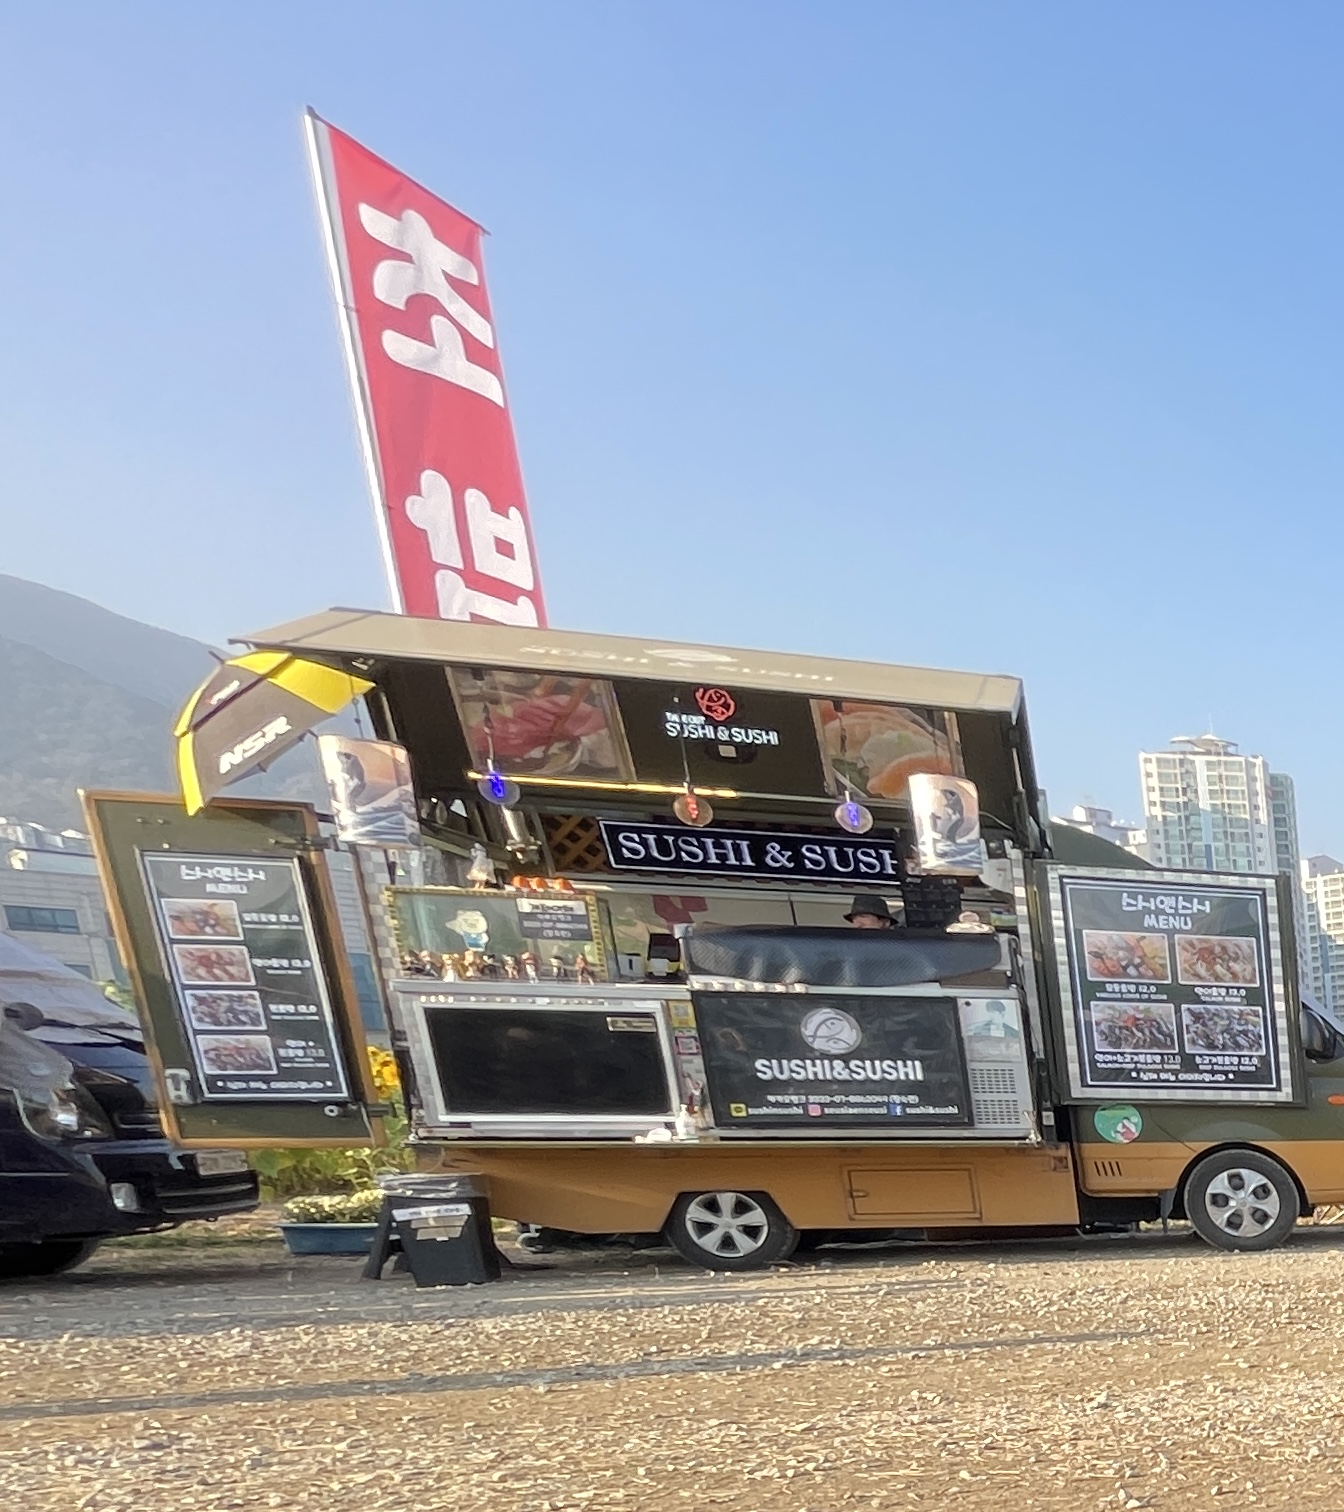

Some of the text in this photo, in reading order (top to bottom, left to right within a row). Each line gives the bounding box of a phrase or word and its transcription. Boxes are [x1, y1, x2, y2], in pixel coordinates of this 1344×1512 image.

[219, 716, 293, 774] NSR
[717, 726, 730, 742] &
[731, 728, 780, 745] SUSHI
[617, 831, 756, 867] SUSHI
[765, 842, 795, 868] &
[1121, 892, 1211, 914] 스시앤스시
[1143, 915, 1192, 930] MENU
[754, 1058, 925, 1082] SUSHI&SUSHI
